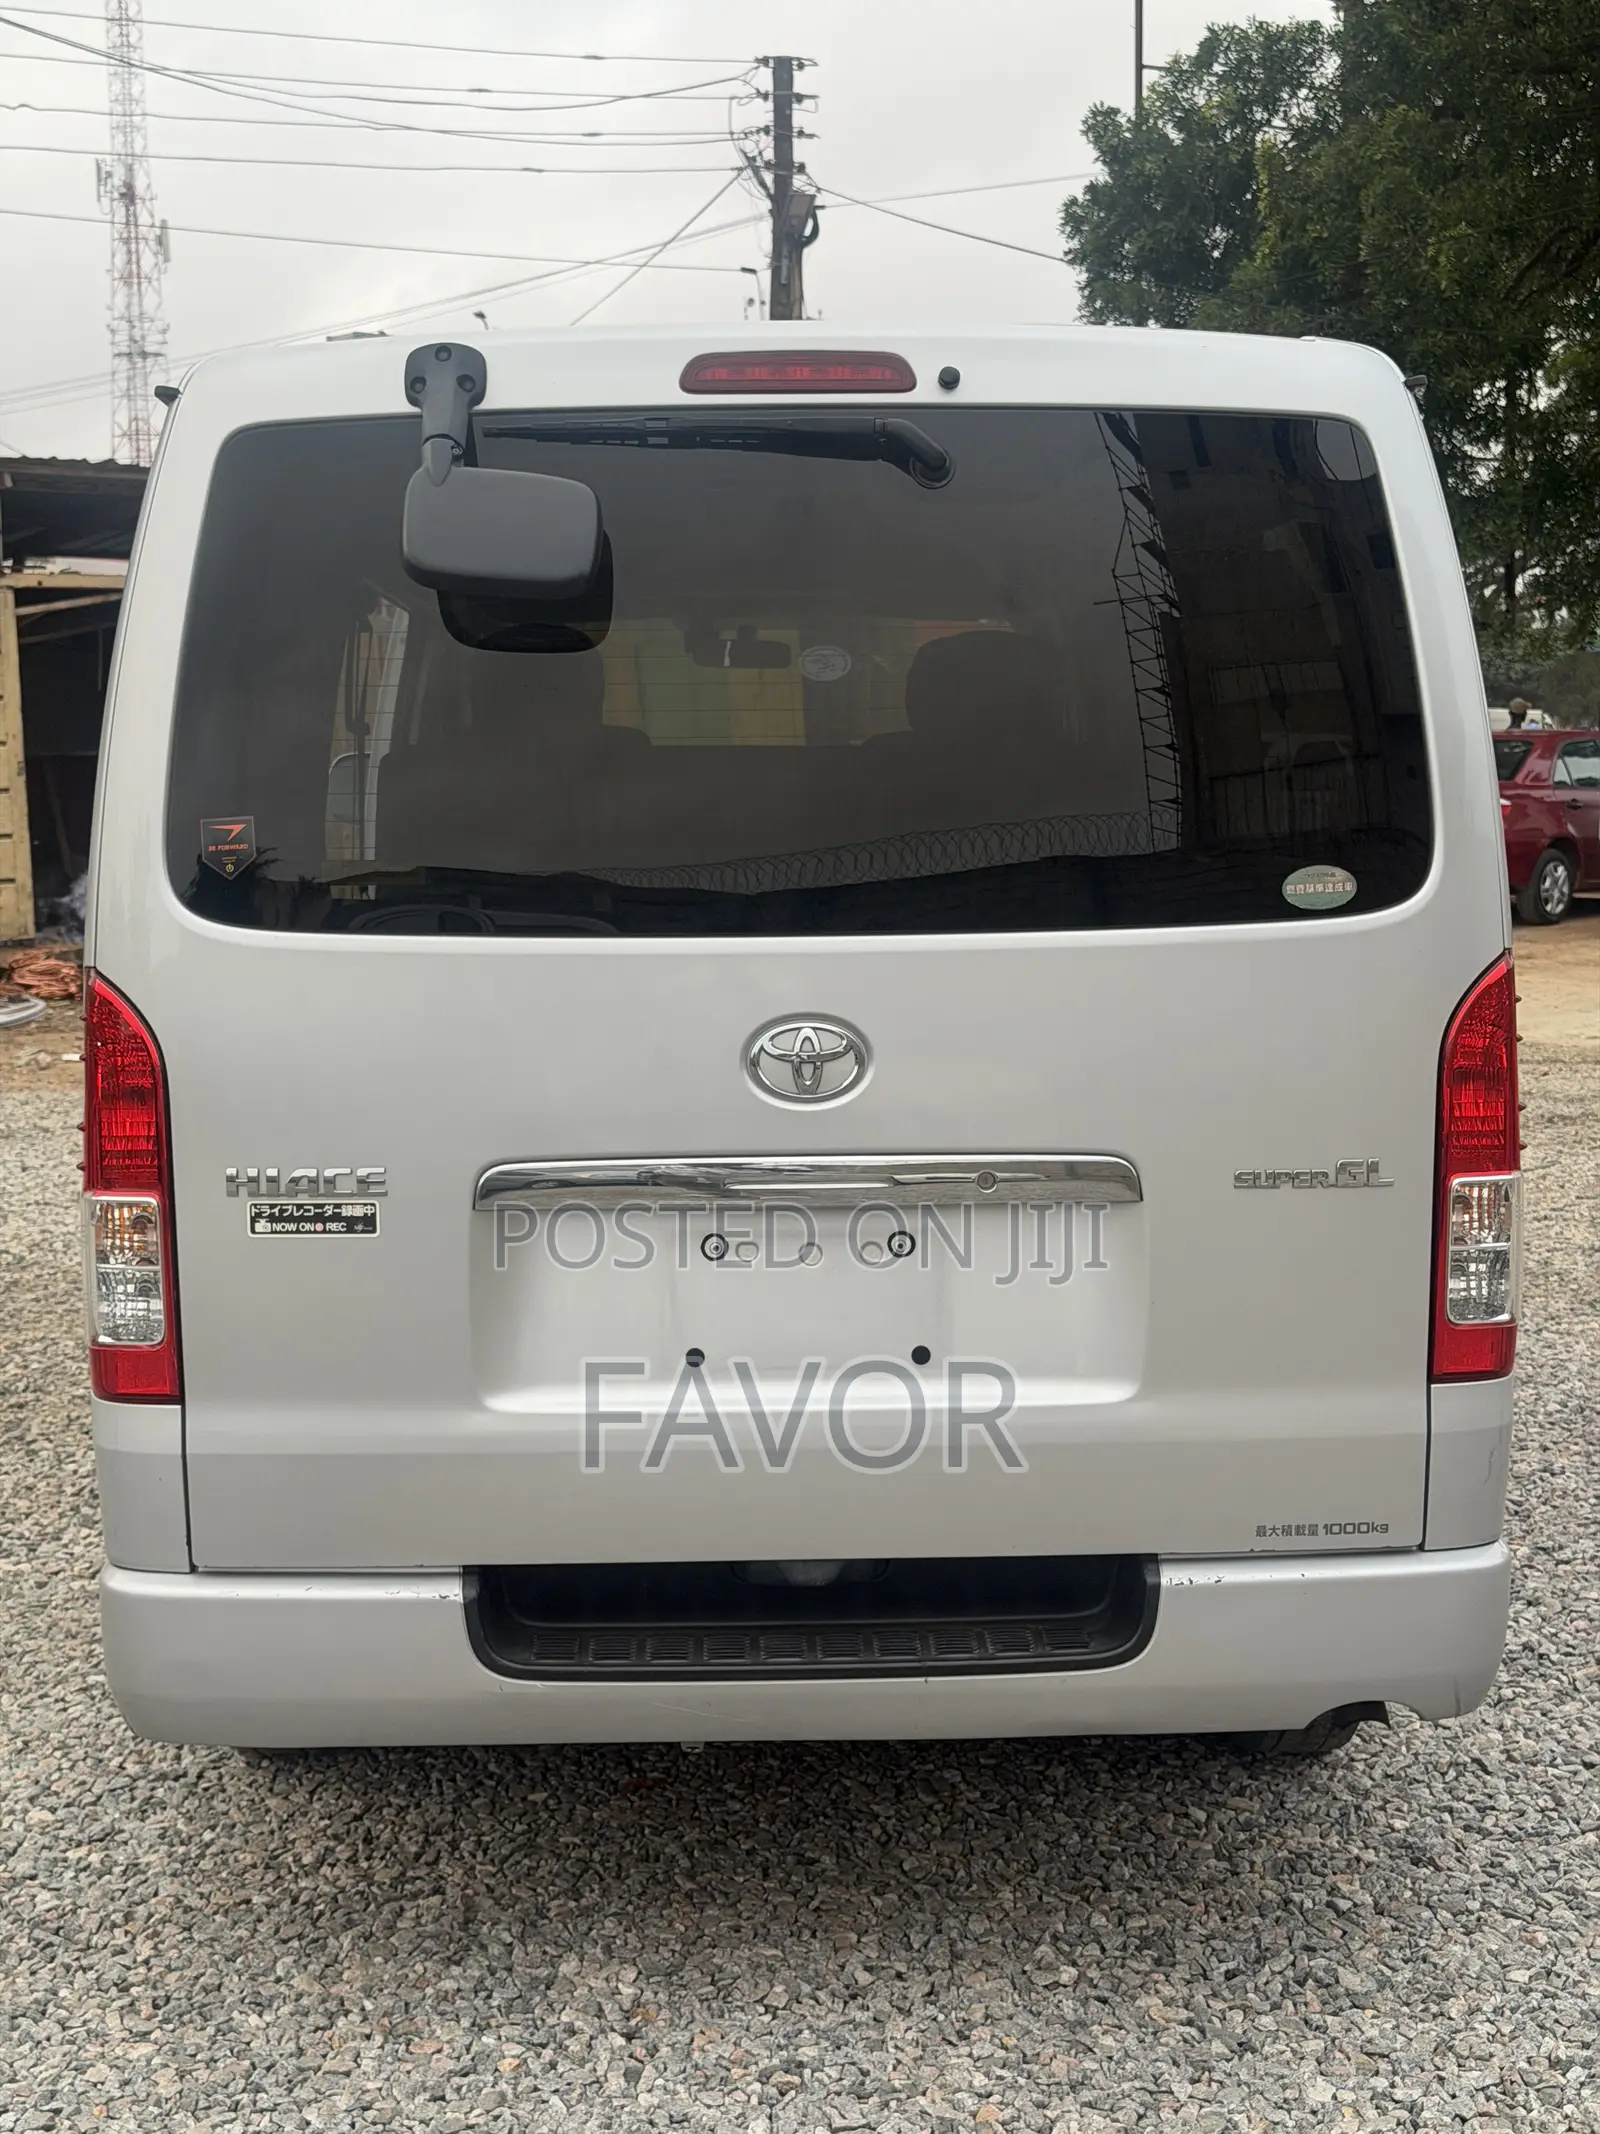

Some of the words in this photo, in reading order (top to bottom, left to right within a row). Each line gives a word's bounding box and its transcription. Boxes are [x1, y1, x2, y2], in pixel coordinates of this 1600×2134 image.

[1233, 1168, 1331, 1189] SUPER
[1336, 1157, 1395, 1189] GL
[226, 1167, 388, 1198] HIACE
[250, 1204, 376, 1218] ドライブレコーダー録画中
[272, 1222, 298, 1232] NOW
[298, 1222, 315, 1232] ON
[325, 1221, 348, 1232] REC
[1255, 1523, 1319, 1538] 最大積載量
[1322, 1521, 1390, 1536] 1000kg
